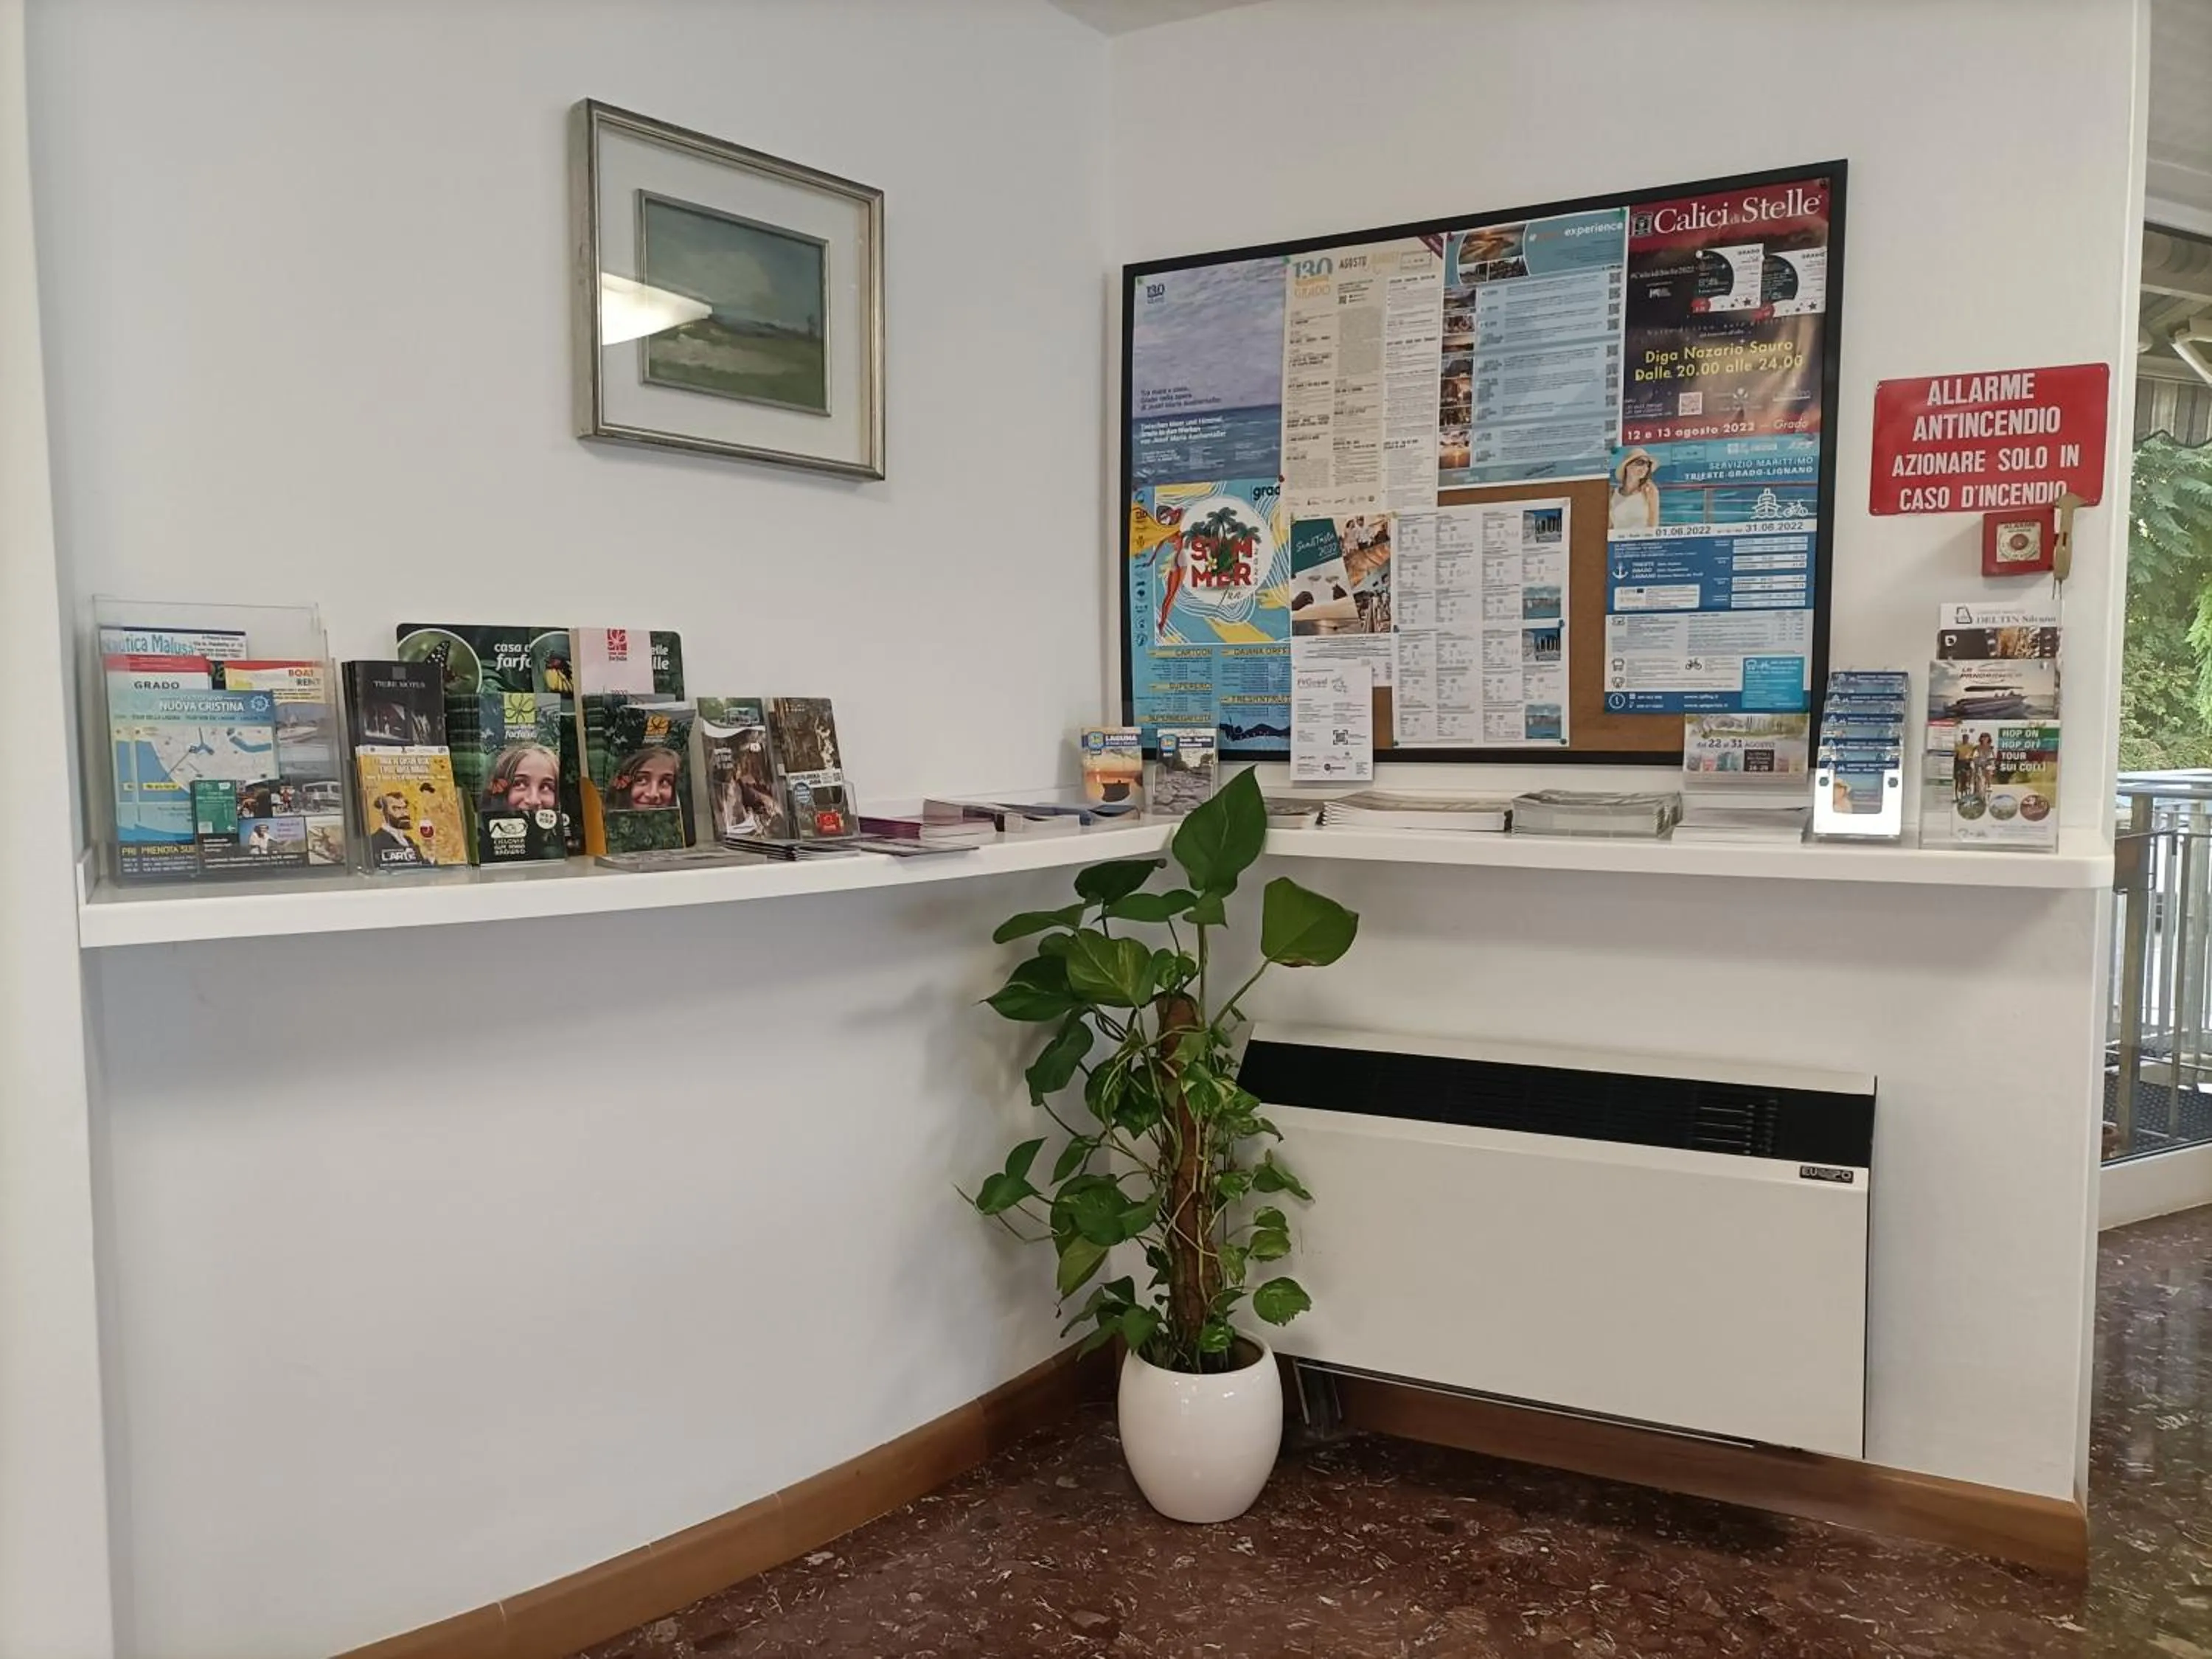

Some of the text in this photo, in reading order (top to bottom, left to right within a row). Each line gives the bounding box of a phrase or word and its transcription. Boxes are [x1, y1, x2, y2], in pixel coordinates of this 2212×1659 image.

[1654, 201, 1729, 234] Calici
[1741, 188, 1821, 223] Stelle
[1564, 222, 1624, 237] experience
[1292, 257, 1334, 279] 130
[1645, 340, 1794, 365] Diga Nazario Sauro
[1634, 355, 1804, 381] Dalle 20.00 alle 24.00
[1927, 372, 2036, 406] ALLARME
[1627, 429, 1641, 440] 12
[1658, 427, 1672, 437] 13
[1674, 426, 1719, 439] agosto
[1723, 422, 1755, 434] 2022
[1773, 417, 1809, 431] Grado
[1912, 406, 2062, 442] ANTINCENDIO
[1709, 456, 1814, 470] SERVIZIO MARITTIMO
[1892, 444, 2080, 477] AZIONARE SOLO IN
[1899, 480, 2067, 511] CASO D'INCENDIO
[494, 643, 522, 653] casa
[288, 669, 314, 677] BOAT
[133, 681, 180, 689] GRADO
[296, 678, 321, 686] RENT
[159, 701, 245, 712] NUOVA CRISTINA
[2001, 729, 2039, 738] HOP ON
[1708, 738, 1722, 748] 22
[1731, 739, 1743, 748] 31
[2001, 739, 2022, 748] HOP
[2001, 751, 2027, 760] TOUR
[2000, 762, 2017, 772] SUI
